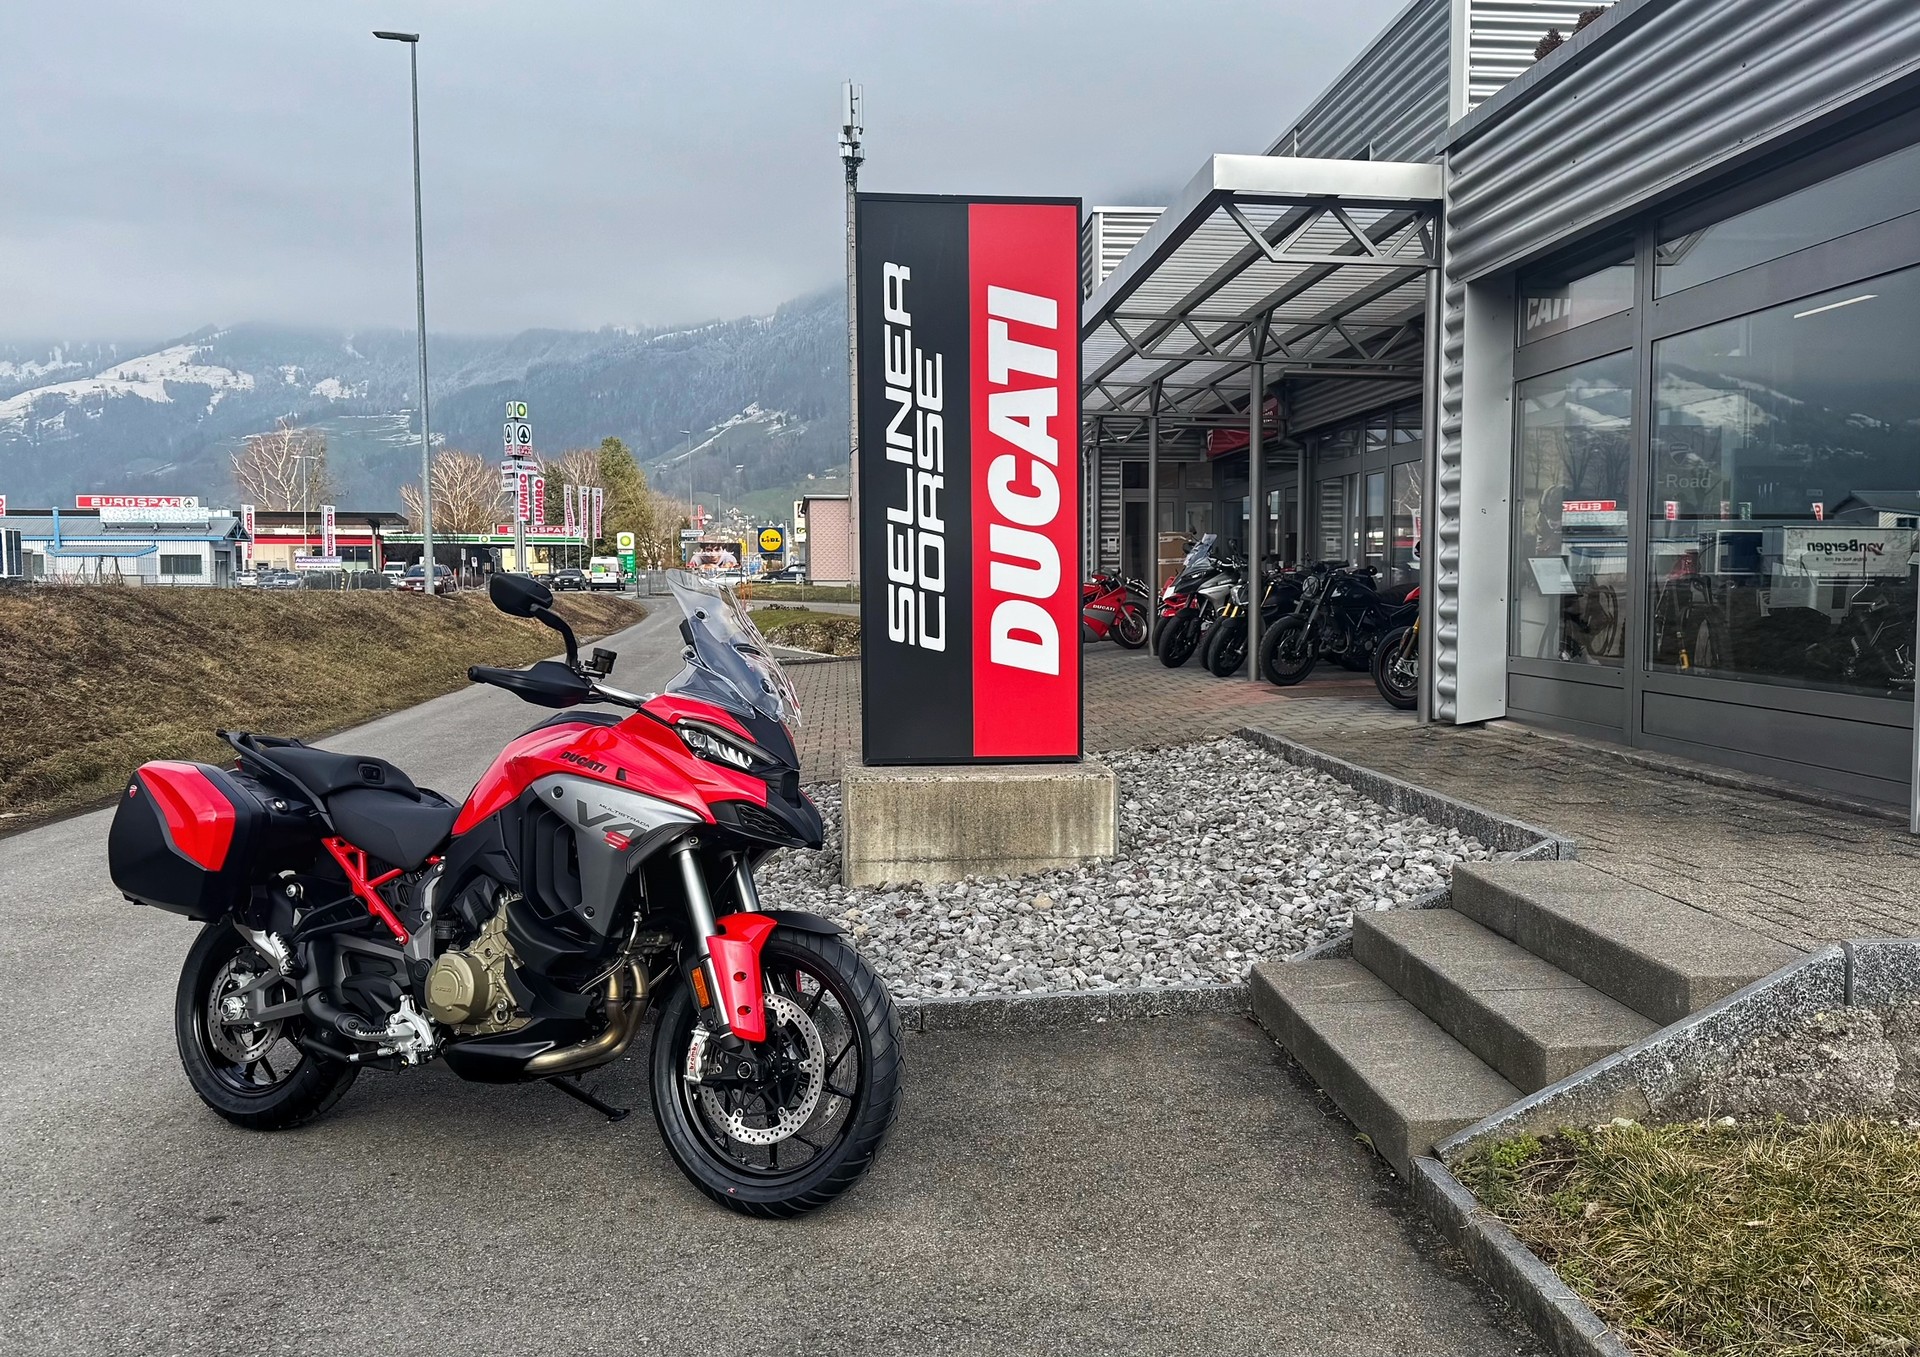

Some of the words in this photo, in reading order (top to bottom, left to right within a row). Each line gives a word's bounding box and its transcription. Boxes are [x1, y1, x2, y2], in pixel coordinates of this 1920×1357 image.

[883, 261, 915, 646] SELINER
[520, 473, 528, 520] JUMBO
[987, 285, 1061, 675] DUCATI
[90, 498, 180, 508] EUROSPAR
[534, 479, 544, 523] JUMBO
[916, 347, 946, 652] CORSE
[1092, 604, 1116, 612] DUCATI
[560, 751, 607, 773] DUCATI
[599, 803, 650, 828] MULTISTRADA
[689, 1042, 698, 1070] brembo
